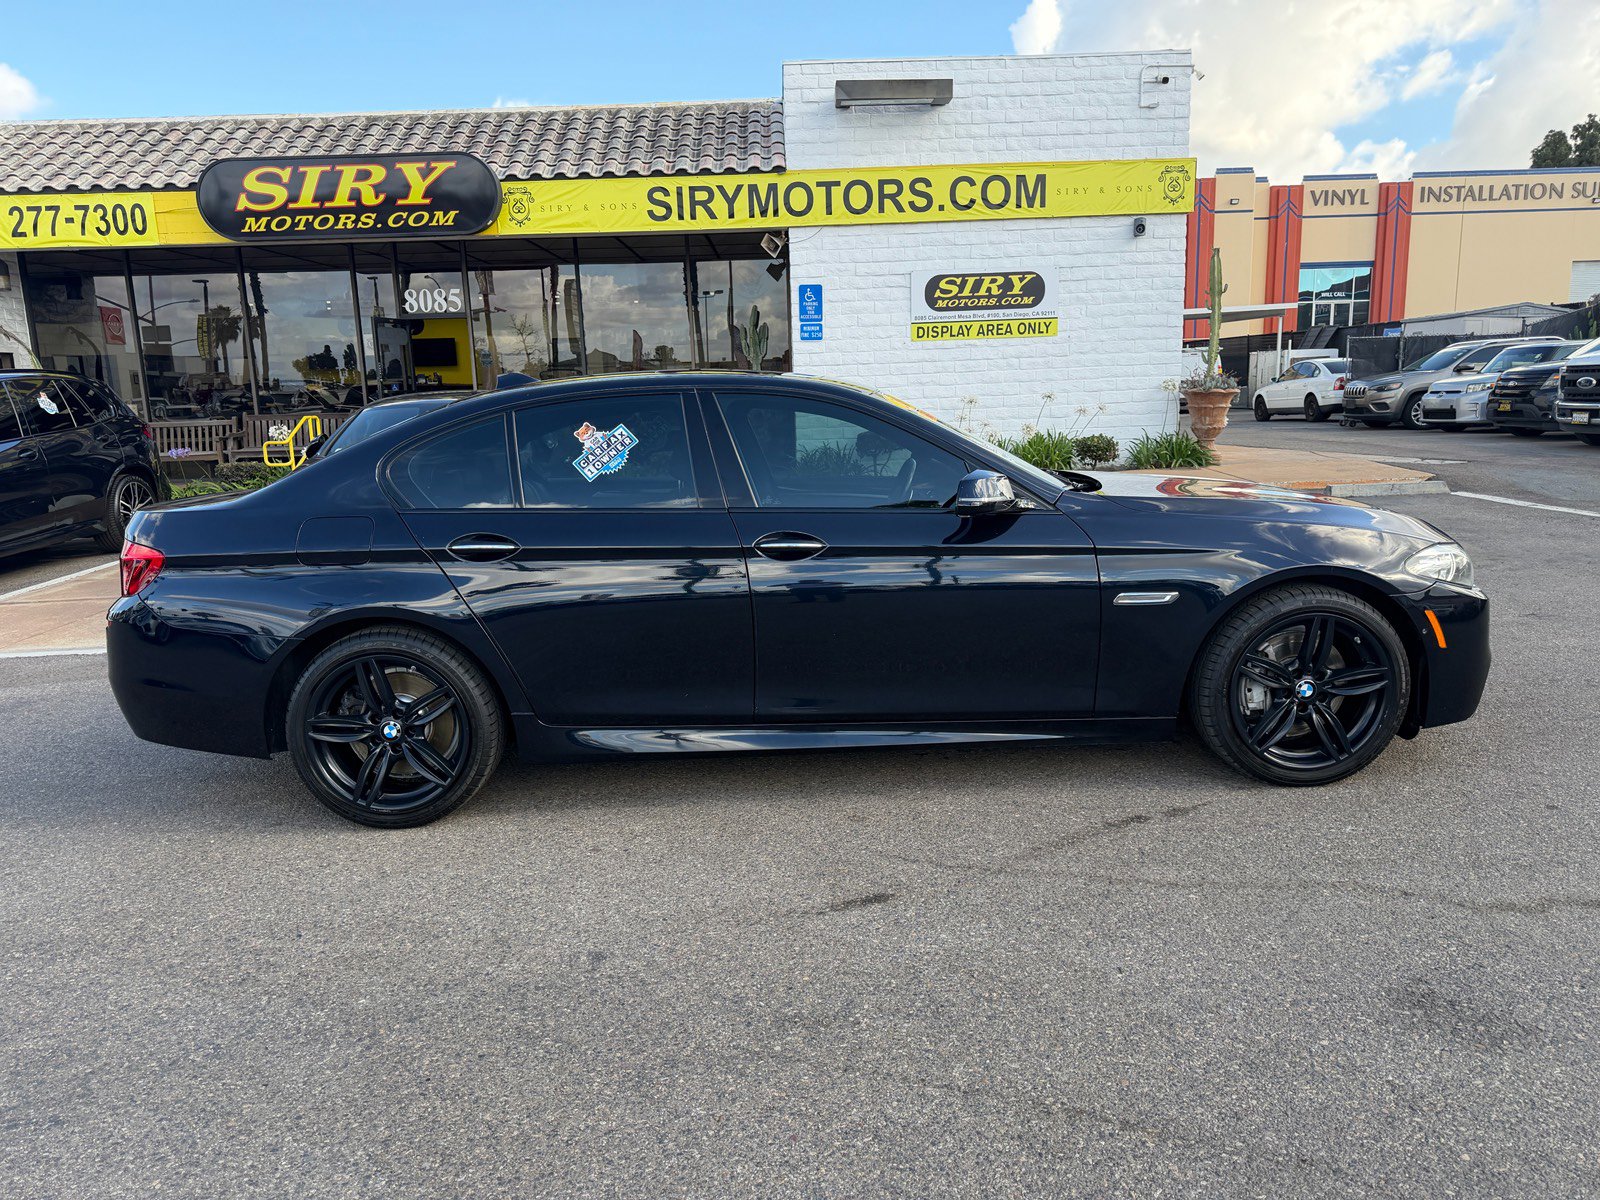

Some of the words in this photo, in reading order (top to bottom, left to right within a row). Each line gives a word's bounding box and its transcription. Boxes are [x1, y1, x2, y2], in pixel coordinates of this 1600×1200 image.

[235, 160, 457, 212] SIRY
[646, 173, 1047, 222] SIRYMOTORS.COM
[1056, 187, 1089, 196] SIRY
[1099, 186, 1105, 194] &
[1116, 184, 1153, 194] SONS
[1310, 188, 1369, 206] VINYL
[1419, 182, 1565, 203] INSTALLATION
[1571, 181, 1600, 199] SU
[540, 204, 573, 213] SIRY
[583, 204, 590, 212] &
[600, 202, 637, 211] SONS
[8, 203, 148, 238] 277-7300
[241, 210, 459, 233] MOTORS.COM
[934, 274, 1036, 298] SIRY
[402, 288, 462, 313] 8085
[935, 296, 1035, 308] MOTORS.COM
[916, 324, 974, 339] DISPLAY
[976, 324, 1014, 337] AREA
[1017, 321, 1053, 335] ONLY
[580, 431, 626, 467] CARFAX
[587, 468, 595, 476] 1
[594, 437, 632, 469] OWNER
